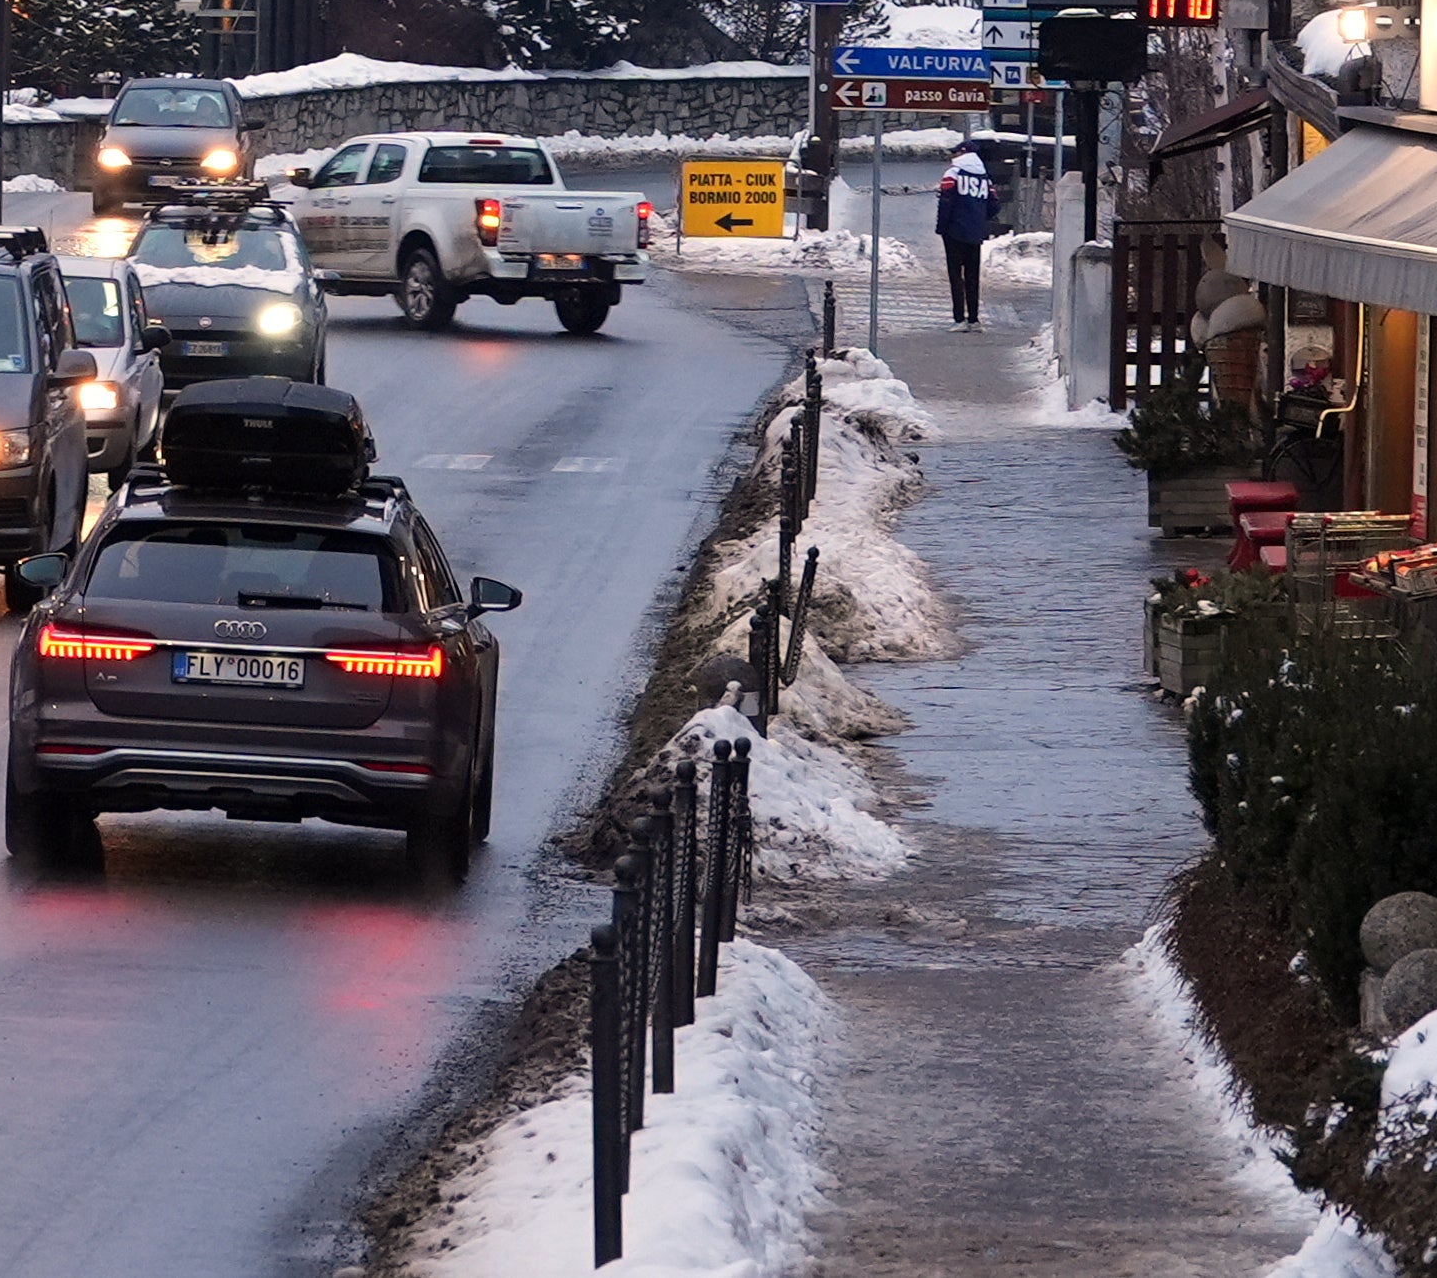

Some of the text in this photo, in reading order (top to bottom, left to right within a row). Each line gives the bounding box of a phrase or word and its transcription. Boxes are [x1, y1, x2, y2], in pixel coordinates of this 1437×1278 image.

[887, 55, 986, 72] VALFURVA
[905, 87, 985, 104] passo Gavia
[689, 173, 733, 186] PIATTA
[746, 173, 777, 186] CIUK
[957, 175, 989, 200] USA
[689, 191, 777, 204] BORMIO 2000
[186, 655, 225, 677] FLY
[237, 657, 299, 681] 00016
